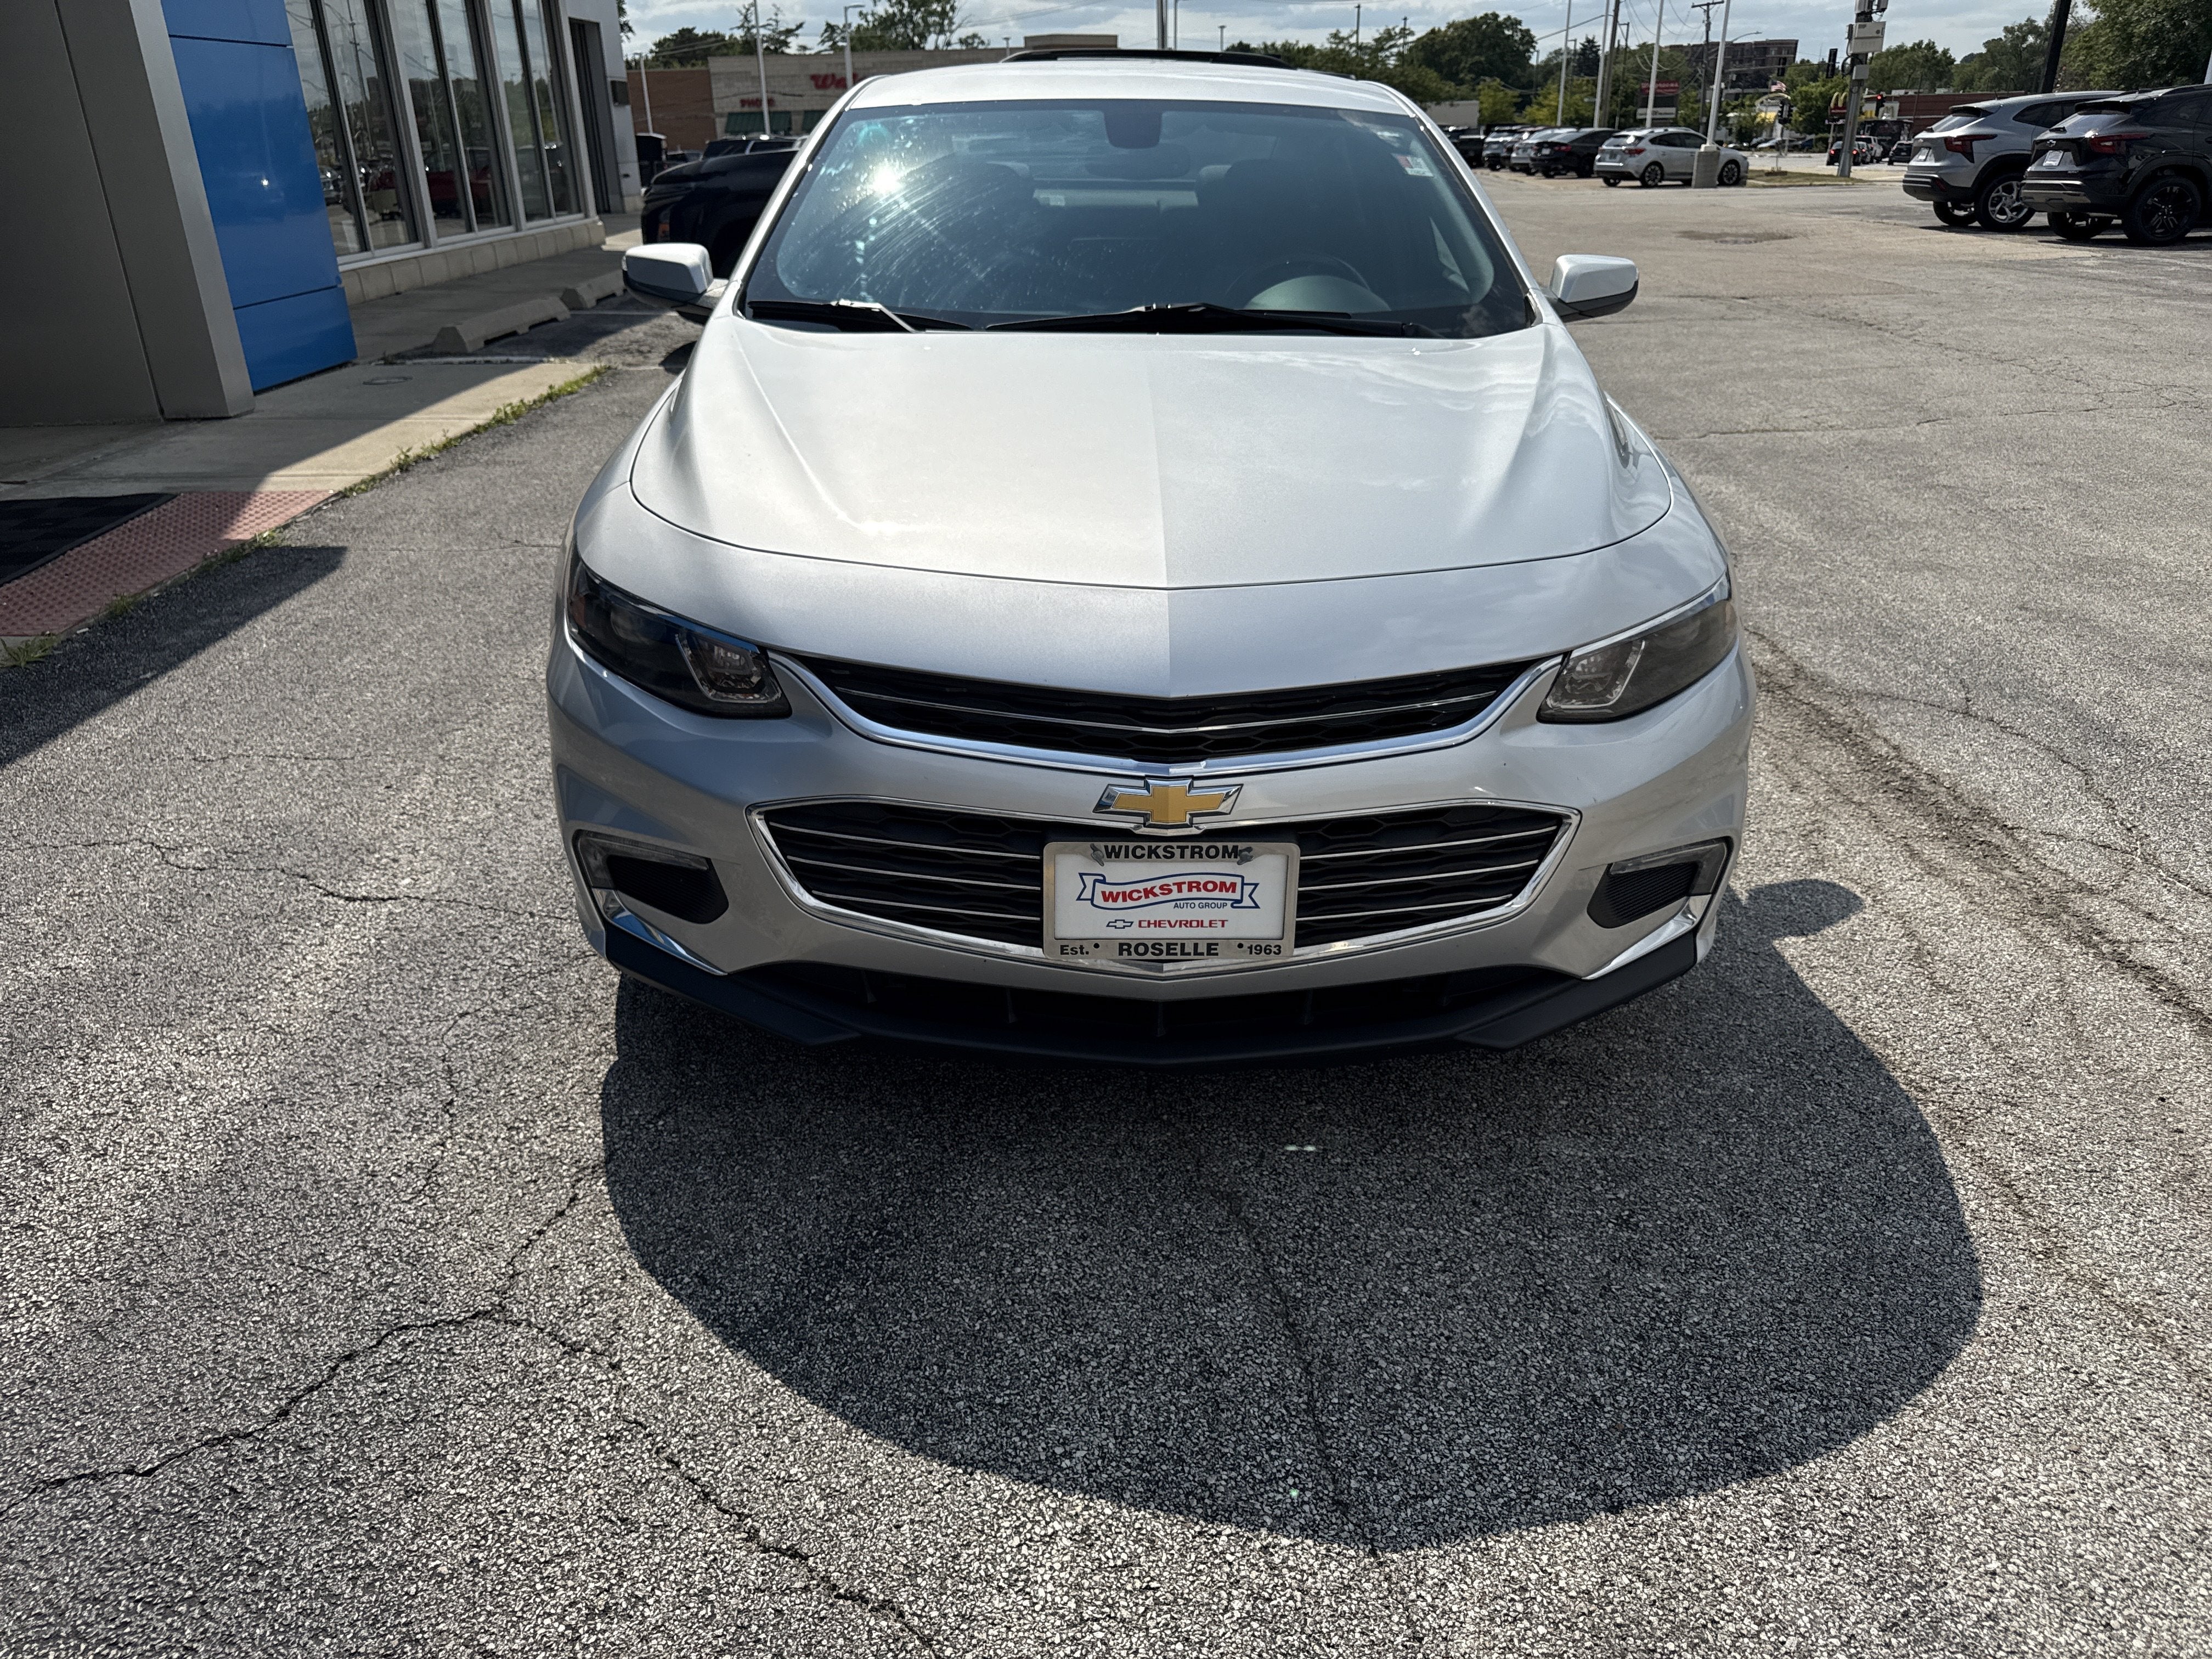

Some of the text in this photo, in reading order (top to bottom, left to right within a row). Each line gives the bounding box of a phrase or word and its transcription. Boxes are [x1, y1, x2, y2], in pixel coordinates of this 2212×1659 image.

[1104, 845, 1238, 859] WICKSTROM
[1101, 881, 1237, 902] WICKSTROM
[1138, 919, 1228, 928] CHEVROLET
[1060, 943, 1282, 956] Est. ROSELLE 1963
